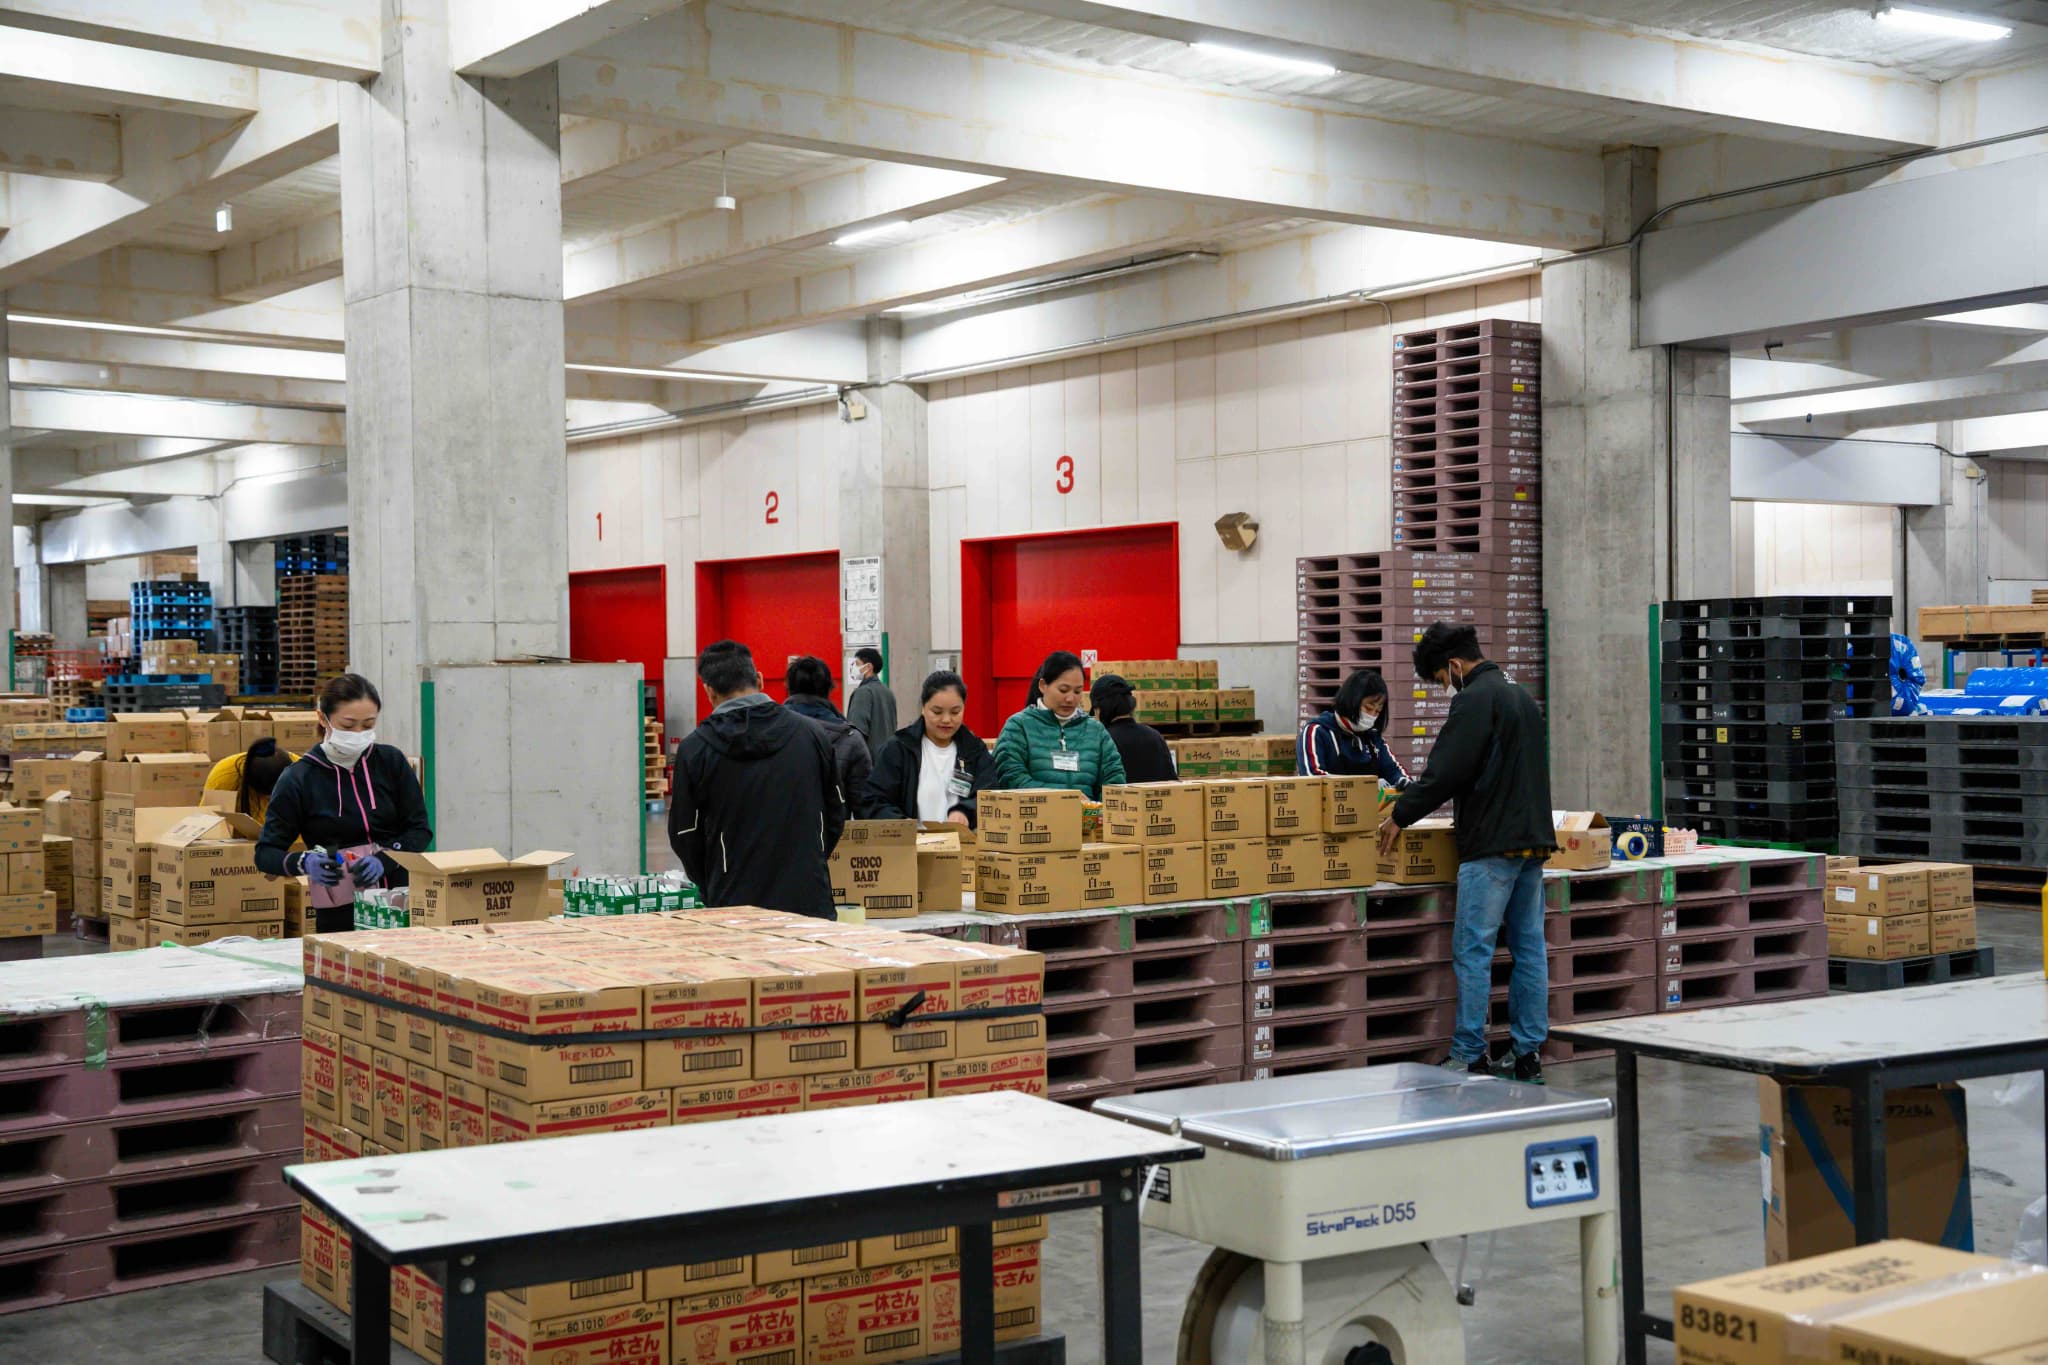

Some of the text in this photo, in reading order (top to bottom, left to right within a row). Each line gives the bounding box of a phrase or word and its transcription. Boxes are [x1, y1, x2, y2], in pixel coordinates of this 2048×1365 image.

[1055, 455, 1075, 494] 3
[765, 491, 779, 524] 2
[596, 512, 602, 537] 1
[851, 856, 882, 869] CHOCO
[854, 870, 880, 882] BABY
[451, 879, 473, 889] meiji
[483, 880, 515, 896] CHOCO
[486, 896, 512, 910] BABY
[1255, 944, 1270, 958] JPR
[992, 985, 1039, 1005] 一休さん
[1255, 985, 1270, 1000] JPR
[689, 1010, 744, 1028] 一休さん
[795, 1003, 848, 1024] 一休さん
[1255, 1026, 1270, 1041] JPR
[839, 1077, 850, 1087] 60
[852, 1075, 871, 1086] 1010
[1254, 1067, 1269, 1081] JPR
[699, 1092, 710, 1102] 60
[712, 1089, 733, 1101] 1010
[570, 1106, 581, 1117] 60
[584, 1103, 606, 1115] 1010
[1306, 1212, 1380, 1236] StraPack
[1383, 1201, 1416, 1224] D55
[838, 1276, 848, 1287] 60
[851, 1273, 870, 1285] 1010
[708, 1298, 720, 1309] 60
[722, 1294, 742, 1306] 1010
[858, 1289, 919, 1312] 一休さん
[567, 1322, 579, 1333] 60
[582, 1317, 604, 1330] 1010
[730, 1309, 794, 1334] 一休さん
[1681, 1304, 1758, 1343] 83821
[590, 1334, 659, 1359] 一休さん
